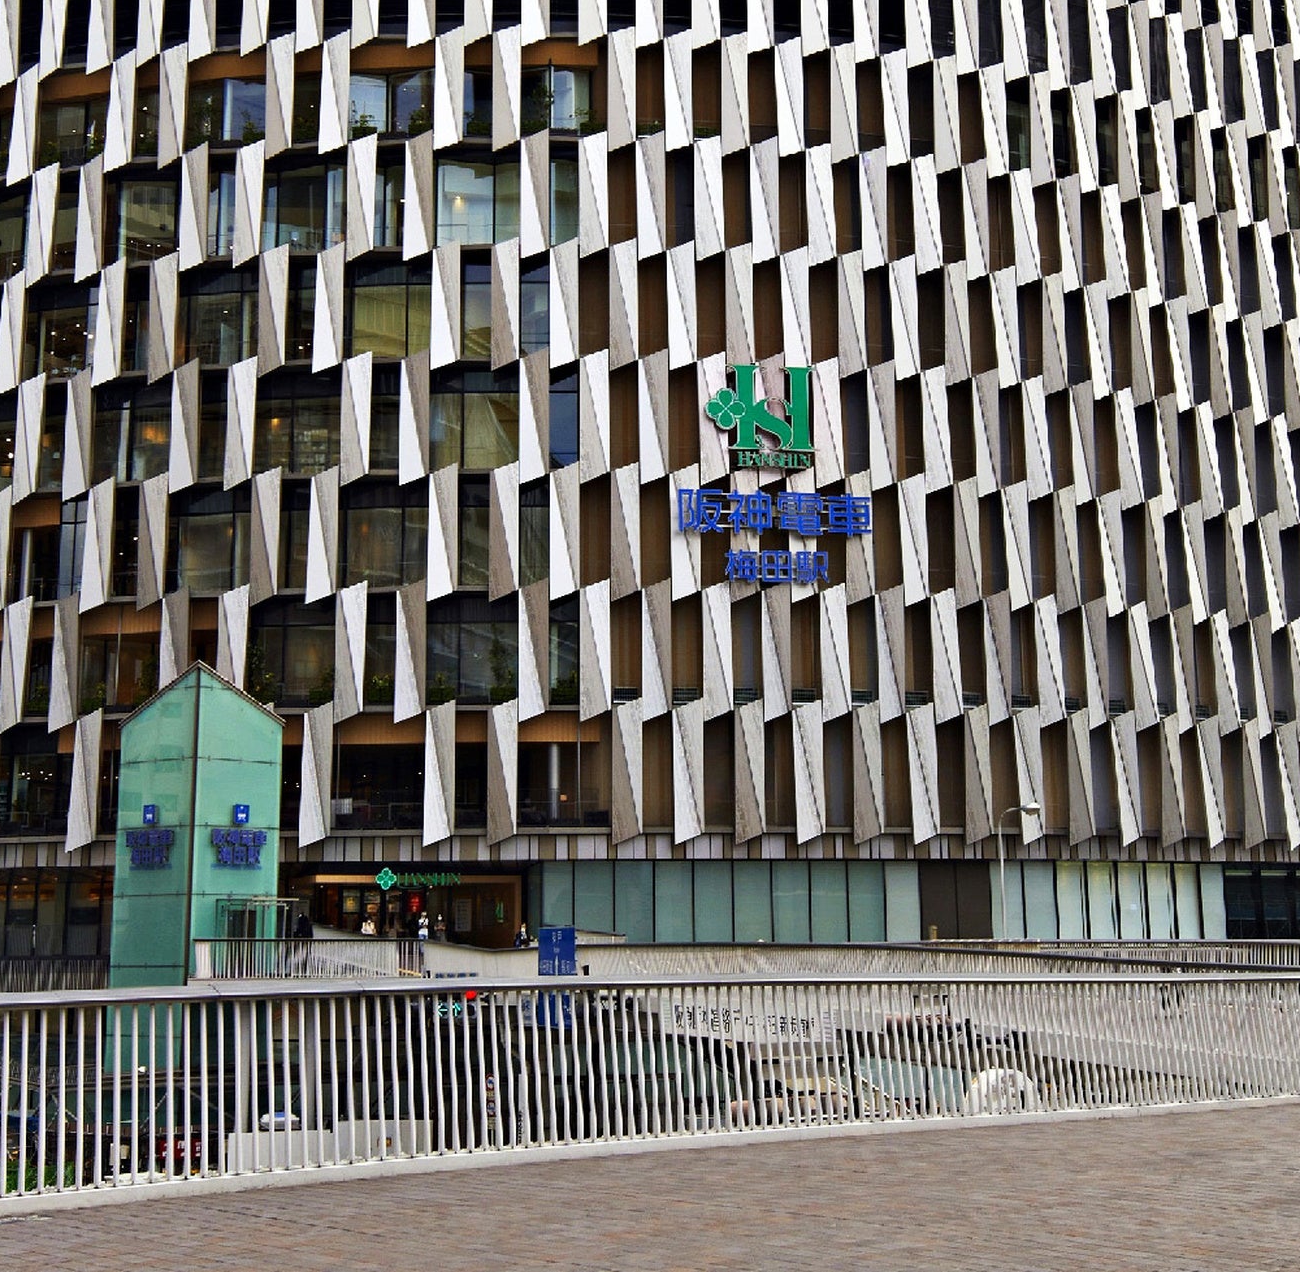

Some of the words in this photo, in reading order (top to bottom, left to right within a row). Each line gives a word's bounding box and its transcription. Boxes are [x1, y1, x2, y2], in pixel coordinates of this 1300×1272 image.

[737, 452, 812, 468] HANSHIN
[677, 488, 873, 537] 阪神電車
[724, 549, 830, 584] 梅田駅
